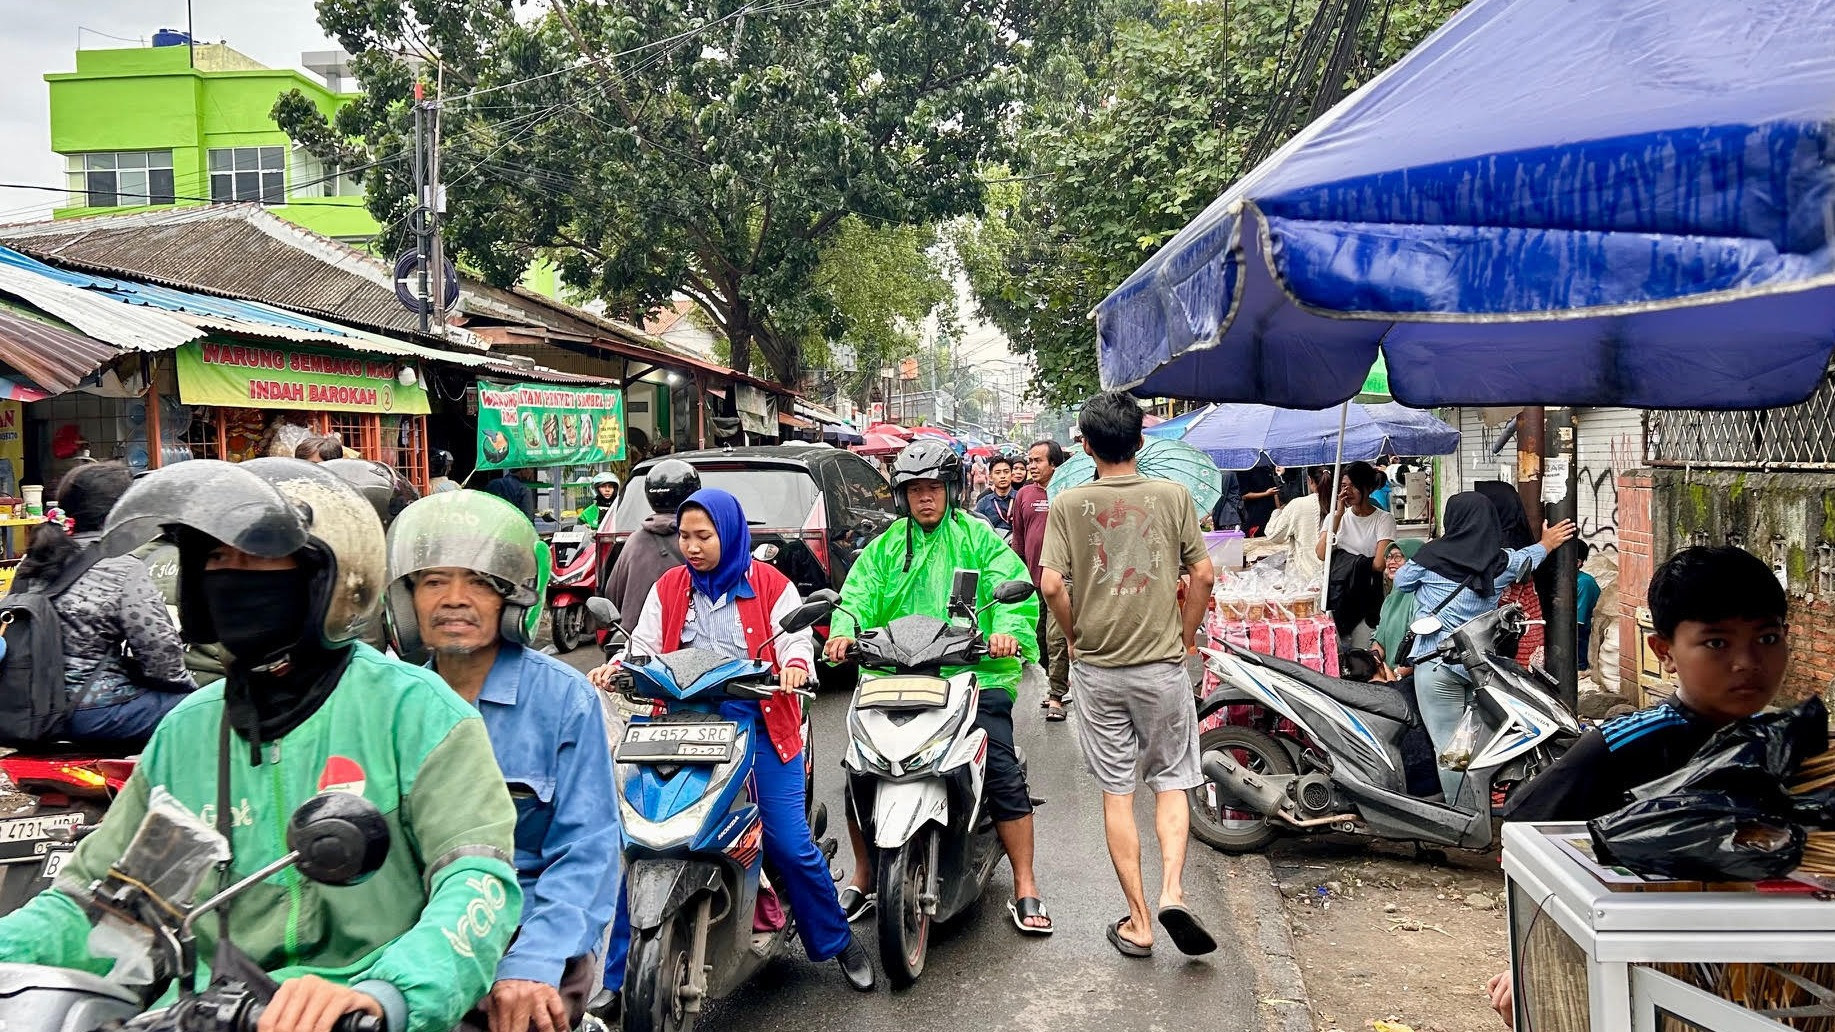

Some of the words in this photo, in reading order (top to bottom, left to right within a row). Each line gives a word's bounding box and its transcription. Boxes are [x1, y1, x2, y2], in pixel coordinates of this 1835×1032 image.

[203, 342, 285, 371] WARUNG
[290, 352, 362, 377] SEMBAKO
[249, 380, 304, 402] INDAH
[308, 384, 377, 406] BAROKAH
[649, 728, 689, 742] 4952
[698, 727, 728, 741] SRC
[8, 821, 42, 839] 4731
